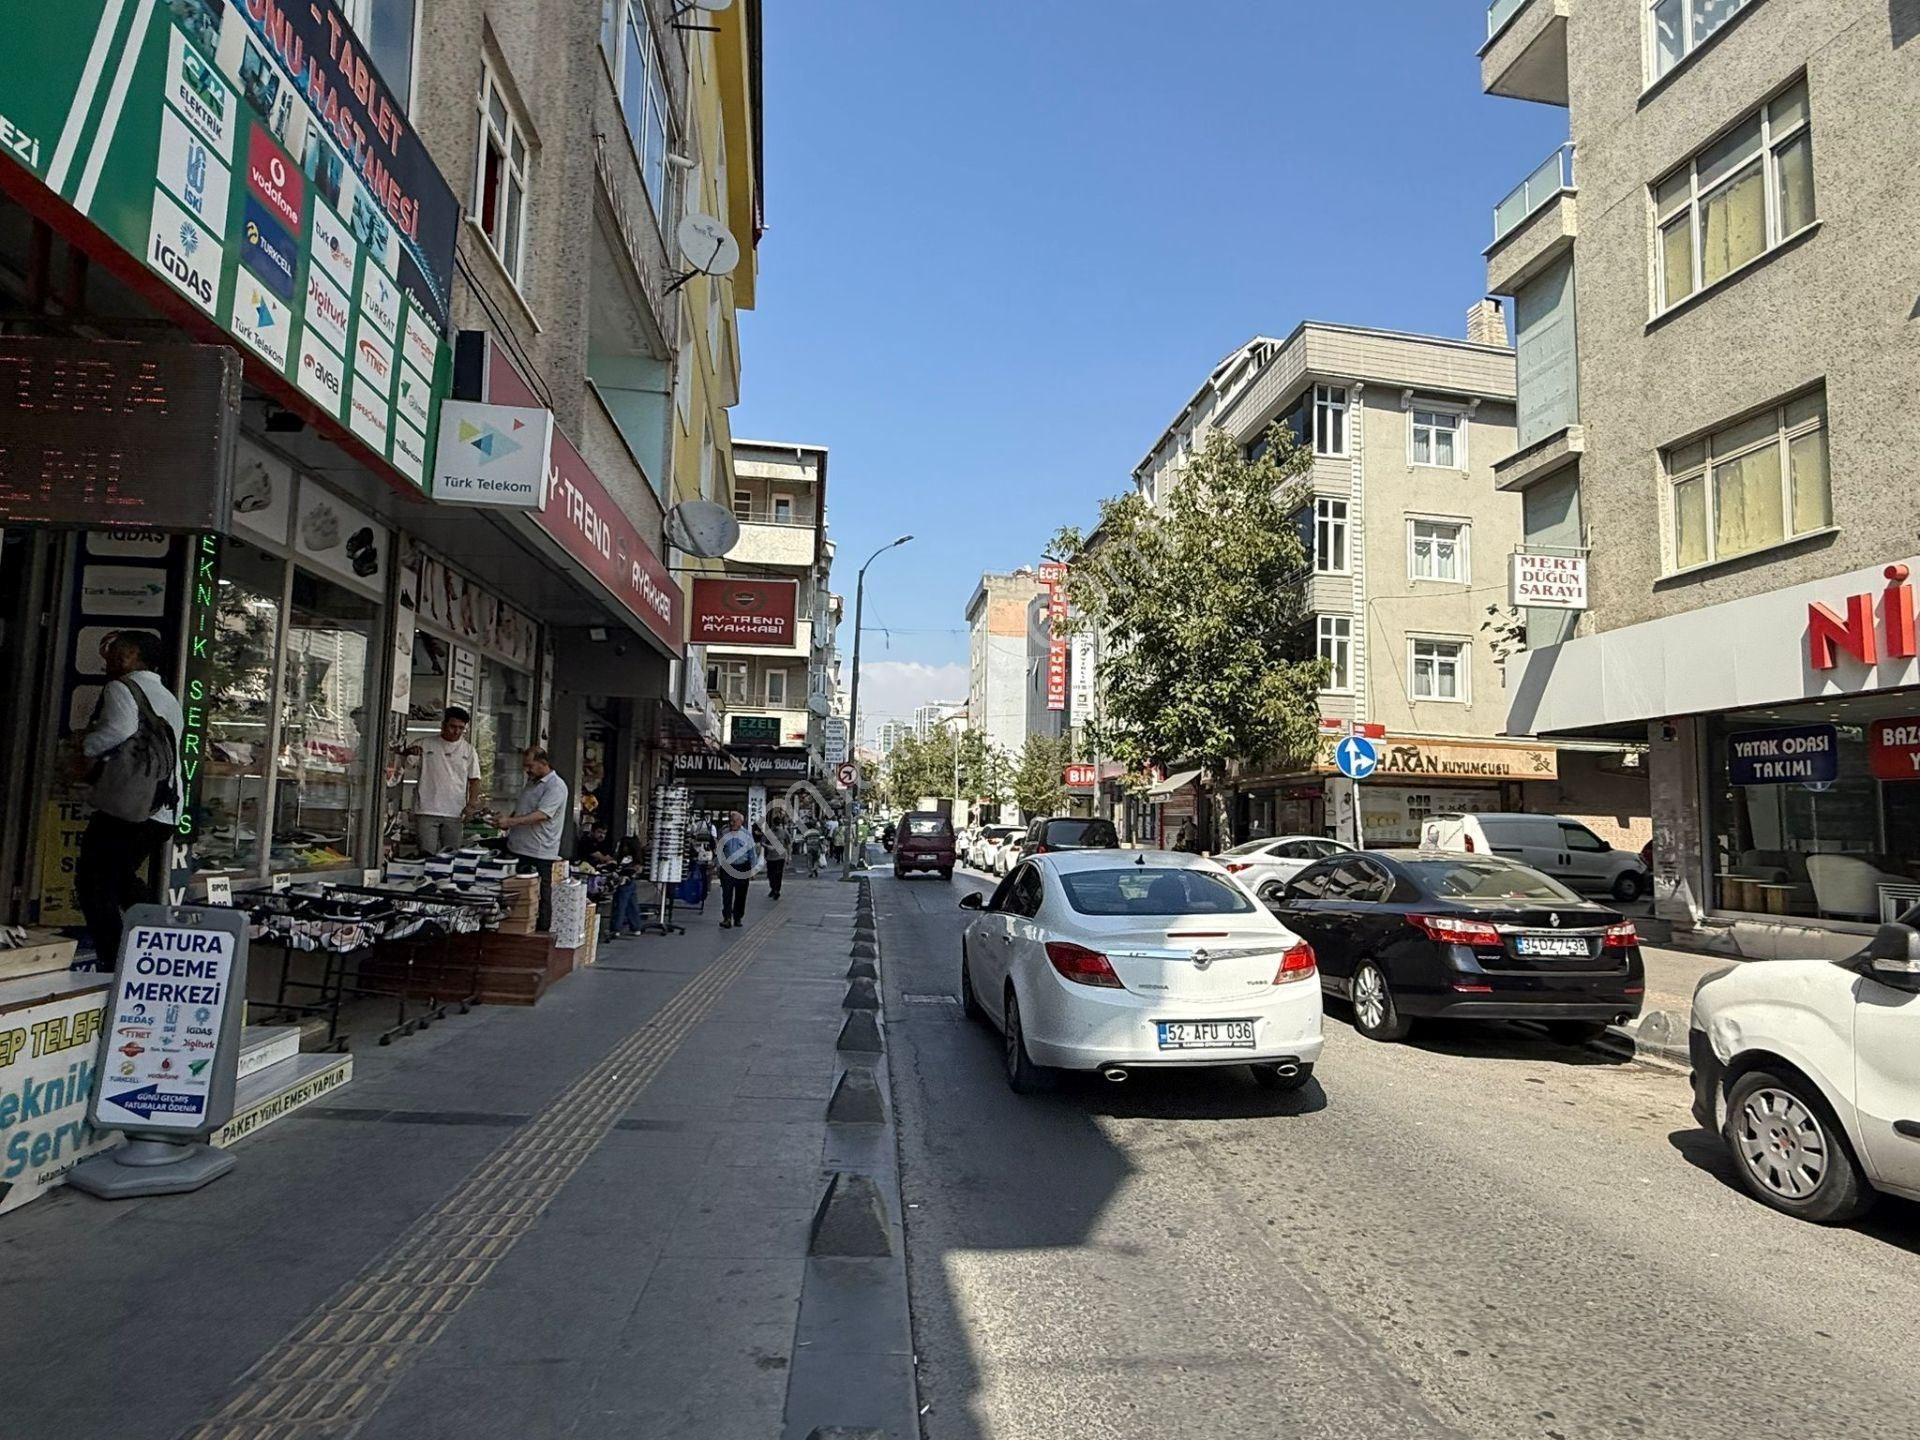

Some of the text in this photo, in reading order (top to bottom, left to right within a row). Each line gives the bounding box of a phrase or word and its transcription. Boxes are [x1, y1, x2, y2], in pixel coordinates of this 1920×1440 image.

[328, 10, 402, 156] TABLET
[180, 84, 222, 139] ELEKTRİK
[307, 56, 419, 241] HASTANESİ
[252, 166, 299, 222] vodafone
[154, 233, 213, 304] İGDAŞ
[235, 316, 285, 367] Türk Telekom
[365, 350, 389, 380] TTNET
[314, 361, 339, 396] avea
[444, 475, 532, 493] Türk Telekom
[1521, 557, 1580, 570] MERT
[1522, 569, 1580, 584] DÜĞÜN
[1519, 584, 1583, 597] SARAYI
[702, 615, 785, 626] MY-TREND
[703, 623, 782, 635] AYAKKABI
[739, 719, 776, 730] EZEL
[1735, 736, 1829, 758] YATAK ODASI
[1882, 727, 1920, 746] BAZ
[1375, 750, 1510, 776] HAKAN KUYUMCUSU
[1753, 760, 1812, 778] TAKIMI
[136, 931, 222, 954] FATURA
[136, 952, 218, 979] ÖDEME
[124, 982, 221, 1005] MERKEZİ
[120, 1015, 155, 1026] BEDAŞ
[1168, 1023, 1251, 1041] 52 AFU 036
[124, 1101, 197, 1112] FATURALAR ÖDENİR
[137, 1092, 160, 1101] GÜNÜ
[222, 1069, 345, 1145] PAKET YÜKLEMESİ YAPILIR
